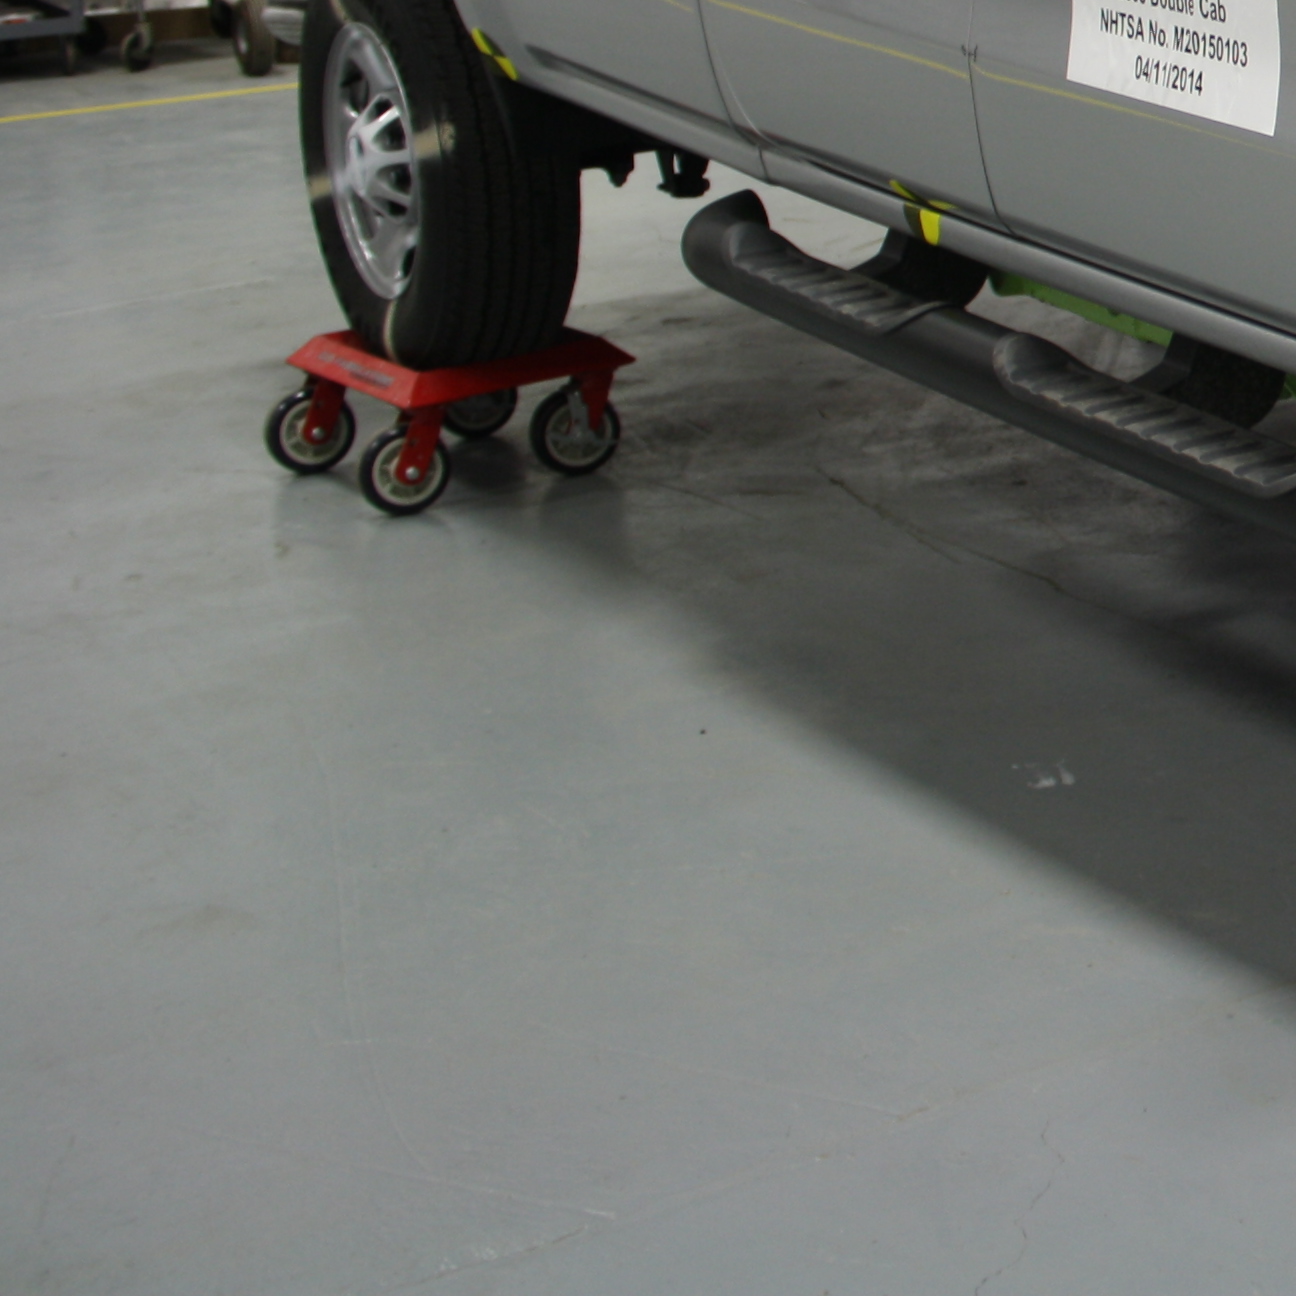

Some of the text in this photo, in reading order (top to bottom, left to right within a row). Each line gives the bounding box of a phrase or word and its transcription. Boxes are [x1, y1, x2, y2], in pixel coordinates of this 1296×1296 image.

[1100, 7, 1248, 68] NHTSA No. M20150103
[1134, 55, 1203, 96] 04/11/2014
